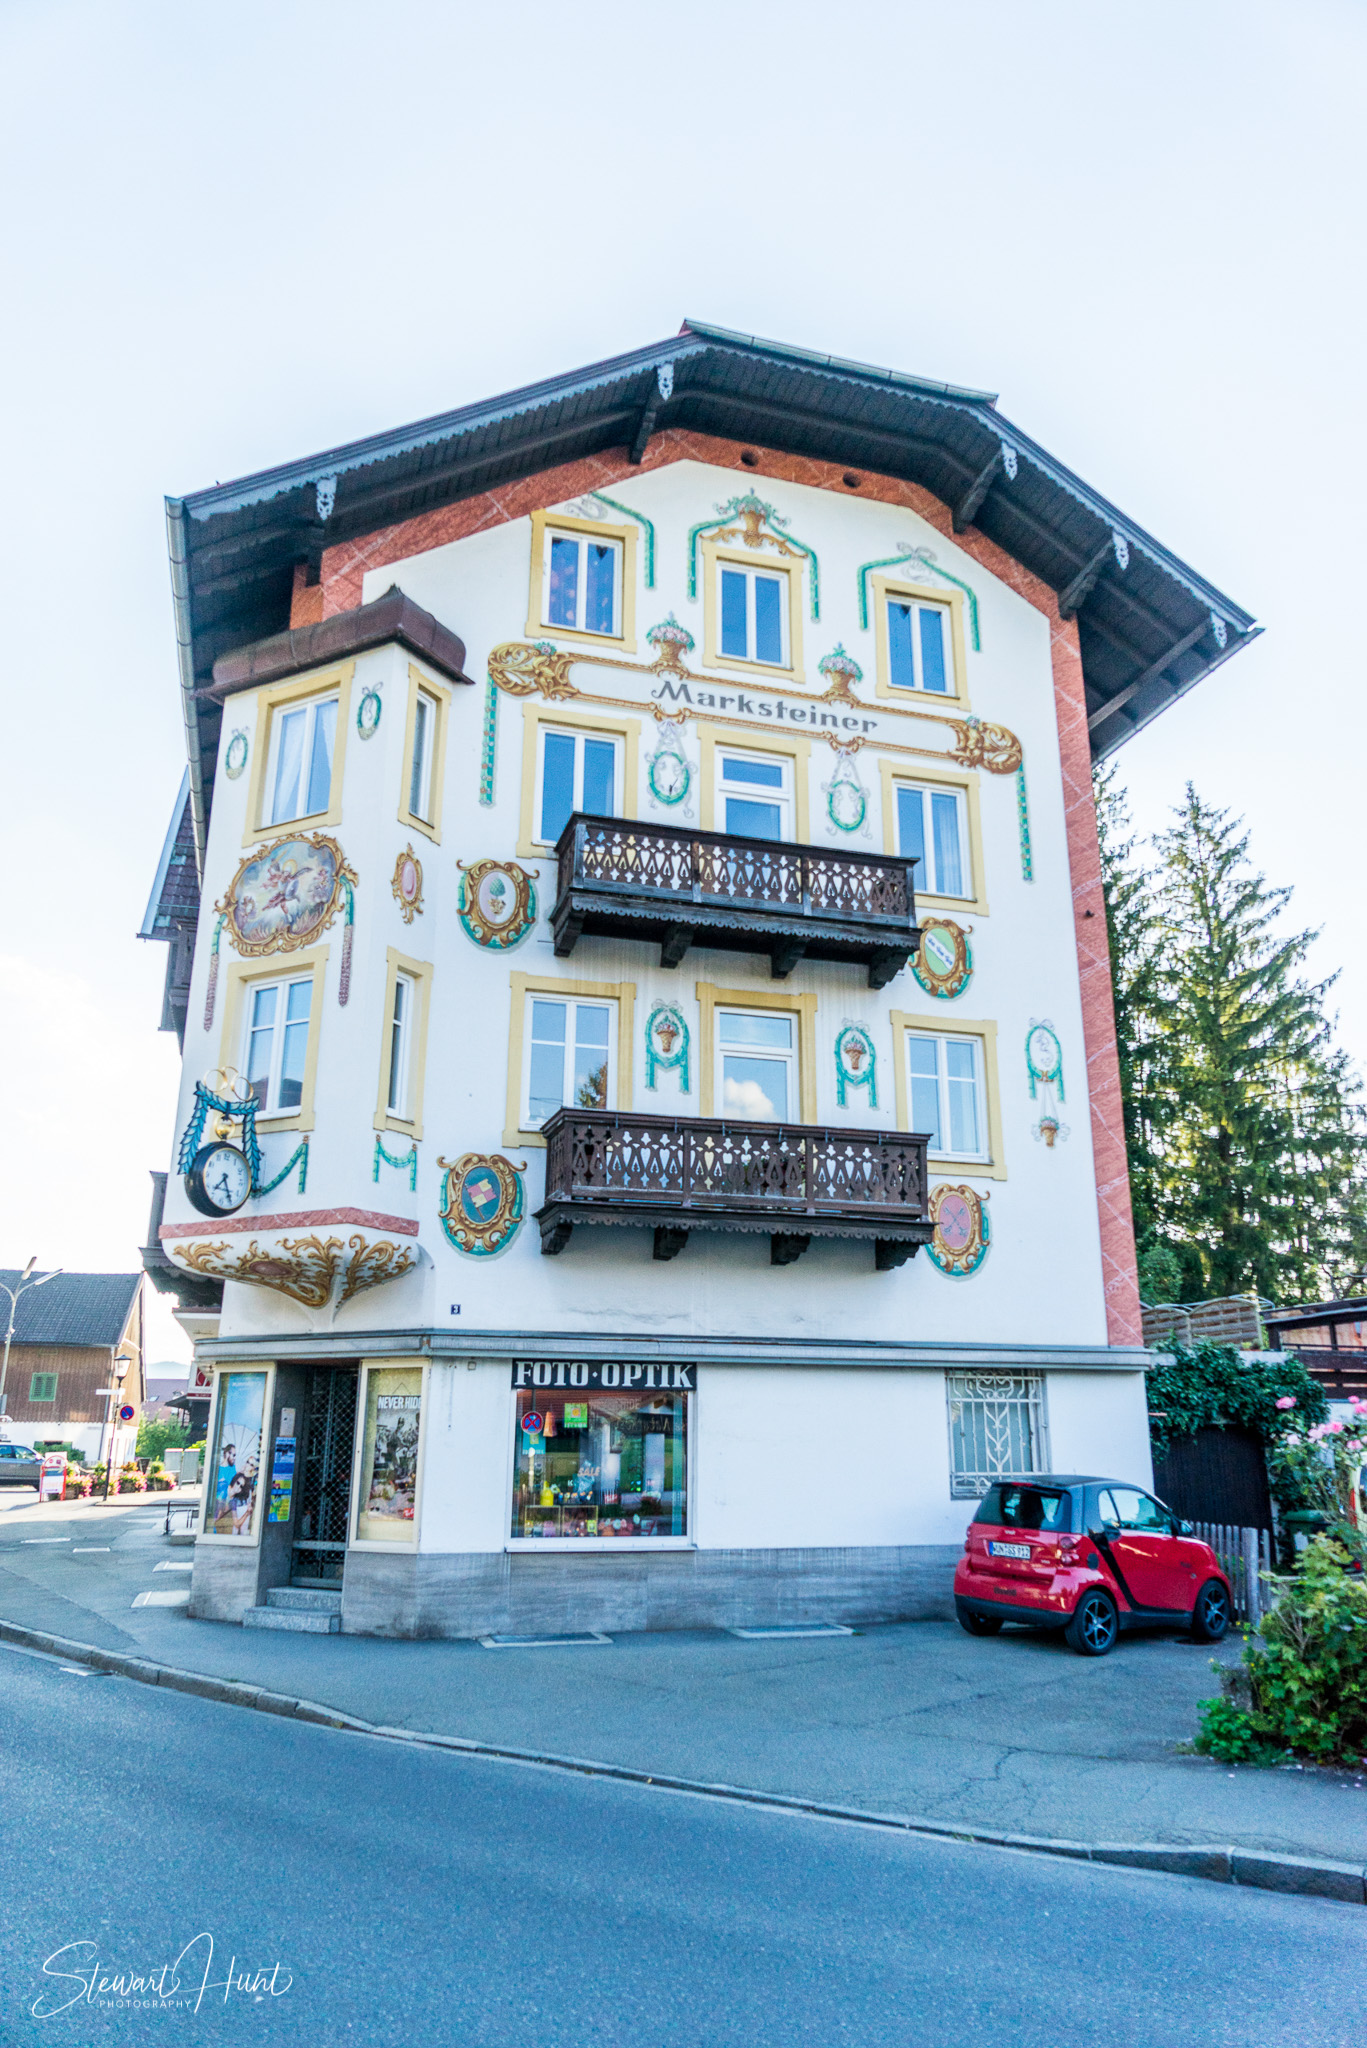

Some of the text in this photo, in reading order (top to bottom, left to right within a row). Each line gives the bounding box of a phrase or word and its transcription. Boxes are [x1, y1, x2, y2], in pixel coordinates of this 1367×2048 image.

[651, 680, 879, 734] Marksteiner
[514, 1360, 694, 1389] FOTO OPTIK
[378, 1396, 404, 1409] NEVER
[577, 1465, 601, 1477] SALE
